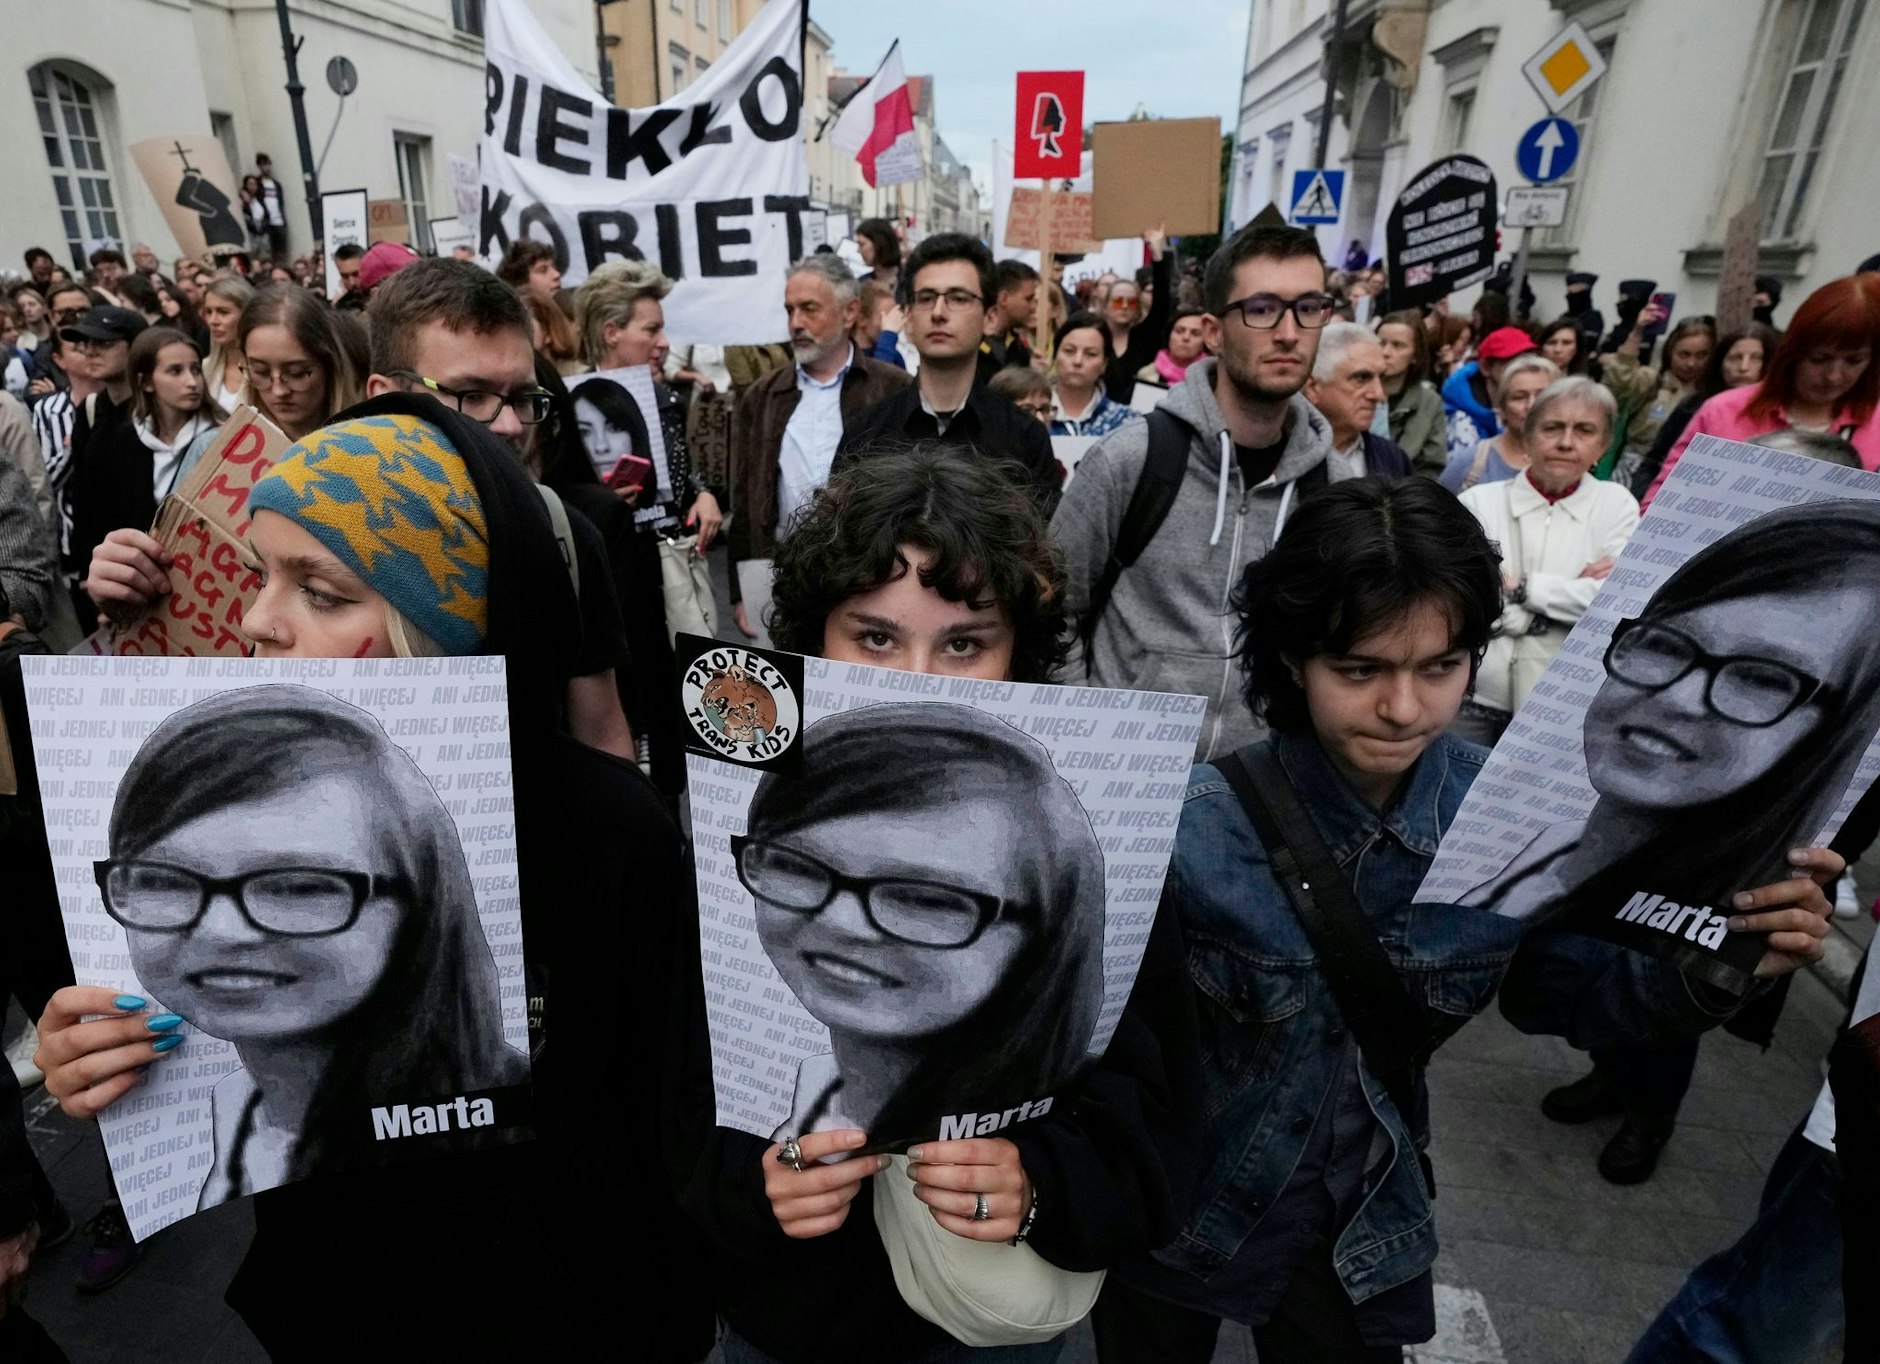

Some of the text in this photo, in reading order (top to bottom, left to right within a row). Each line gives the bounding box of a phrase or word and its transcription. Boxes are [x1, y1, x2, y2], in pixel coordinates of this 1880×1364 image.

[479, 184, 810, 281] KOBIET
[1643, 548, 1690, 568] JEDNE
[1577, 615, 1615, 638] WIĘC
[51, 658, 108, 677] JEDNEJ
[114, 658, 170, 682] WIĘCEJ
[185, 658, 212, 677] ANI
[216, 659, 275, 678] JEDNEJ
[280, 659, 337, 683] WIĘCEJ
[353, 659, 380, 677] ANI
[384, 658, 443, 677] JEDNEJ
[448, 656, 505, 680] WIĘCEJ
[687, 650, 787, 692] PROTECT
[29, 687, 84, 711] WIĘCEJ
[100, 688, 126, 707] ANI
[130, 688, 187, 708] JEDNEJ
[359, 687, 416, 711] WIĘCEJ
[432, 686, 458, 704] ANI
[845, 665, 1207, 718] ANI JEDNEJ WIĘCEJ ANI JEDNEJ WIĘCEJ
[60, 720, 116, 738] JEDNEJ
[390, 715, 508, 739] JEDNEJ WIĘCEJ
[689, 707, 800, 759] TRANS KIDS
[1031, 715, 1146, 742] WIĘCEJ ANI
[38, 749, 91, 772] WIĘCEJ
[437, 744, 462, 762] ANI
[1057, 750, 1193, 778] JEDNEJ WIĘCEJ
[457, 771, 511, 794] WIĘCEJ
[713, 763, 759, 783] JEDNE
[69, 781, 115, 798] JEDNE
[690, 780, 742, 805] WIĘCEJ
[1101, 781, 1135, 798] ANI
[47, 808, 100, 831] WIĘCEJ
[1116, 810, 1181, 833] WIĘCEJ
[1547, 801, 1591, 820] JEDNE
[462, 824, 515, 846] WIĘCEJ
[1107, 864, 1169, 884] WIĘCEJ
[700, 879, 746, 905] WIĘCEJ
[1614, 890, 1730, 951] Marta
[68, 923, 115, 945] WIĘCEJ
[702, 925, 749, 951] WIĘCEJ
[725, 956, 774, 980] JEDNEJ
[704, 969, 785, 1003] WIĘCEJ ANI
[708, 1008, 785, 1043] WIĘCEJ ANI
[728, 996, 775, 1021] JEDNEJ
[778, 1011, 826, 1035] WIĘCEJ
[731, 1035, 777, 1060] JEDNEJ
[164, 1059, 240, 1083] ANI JEDNE
[713, 1046, 786, 1081] WIĘCEJ ANI
[716, 1083, 758, 1106] WIĘCEJ
[734, 1072, 777, 1096] JEDNEJ
[127, 1089, 183, 1116] JEDNEJ
[106, 1108, 199, 1148] WIĘCEJ ANI
[371, 1096, 494, 1141] Marta
[938, 1096, 1054, 1142] Marta
[140, 1135, 193, 1162] JEDNEJ
[118, 1151, 210, 1195] WIĘCEJ ANI
